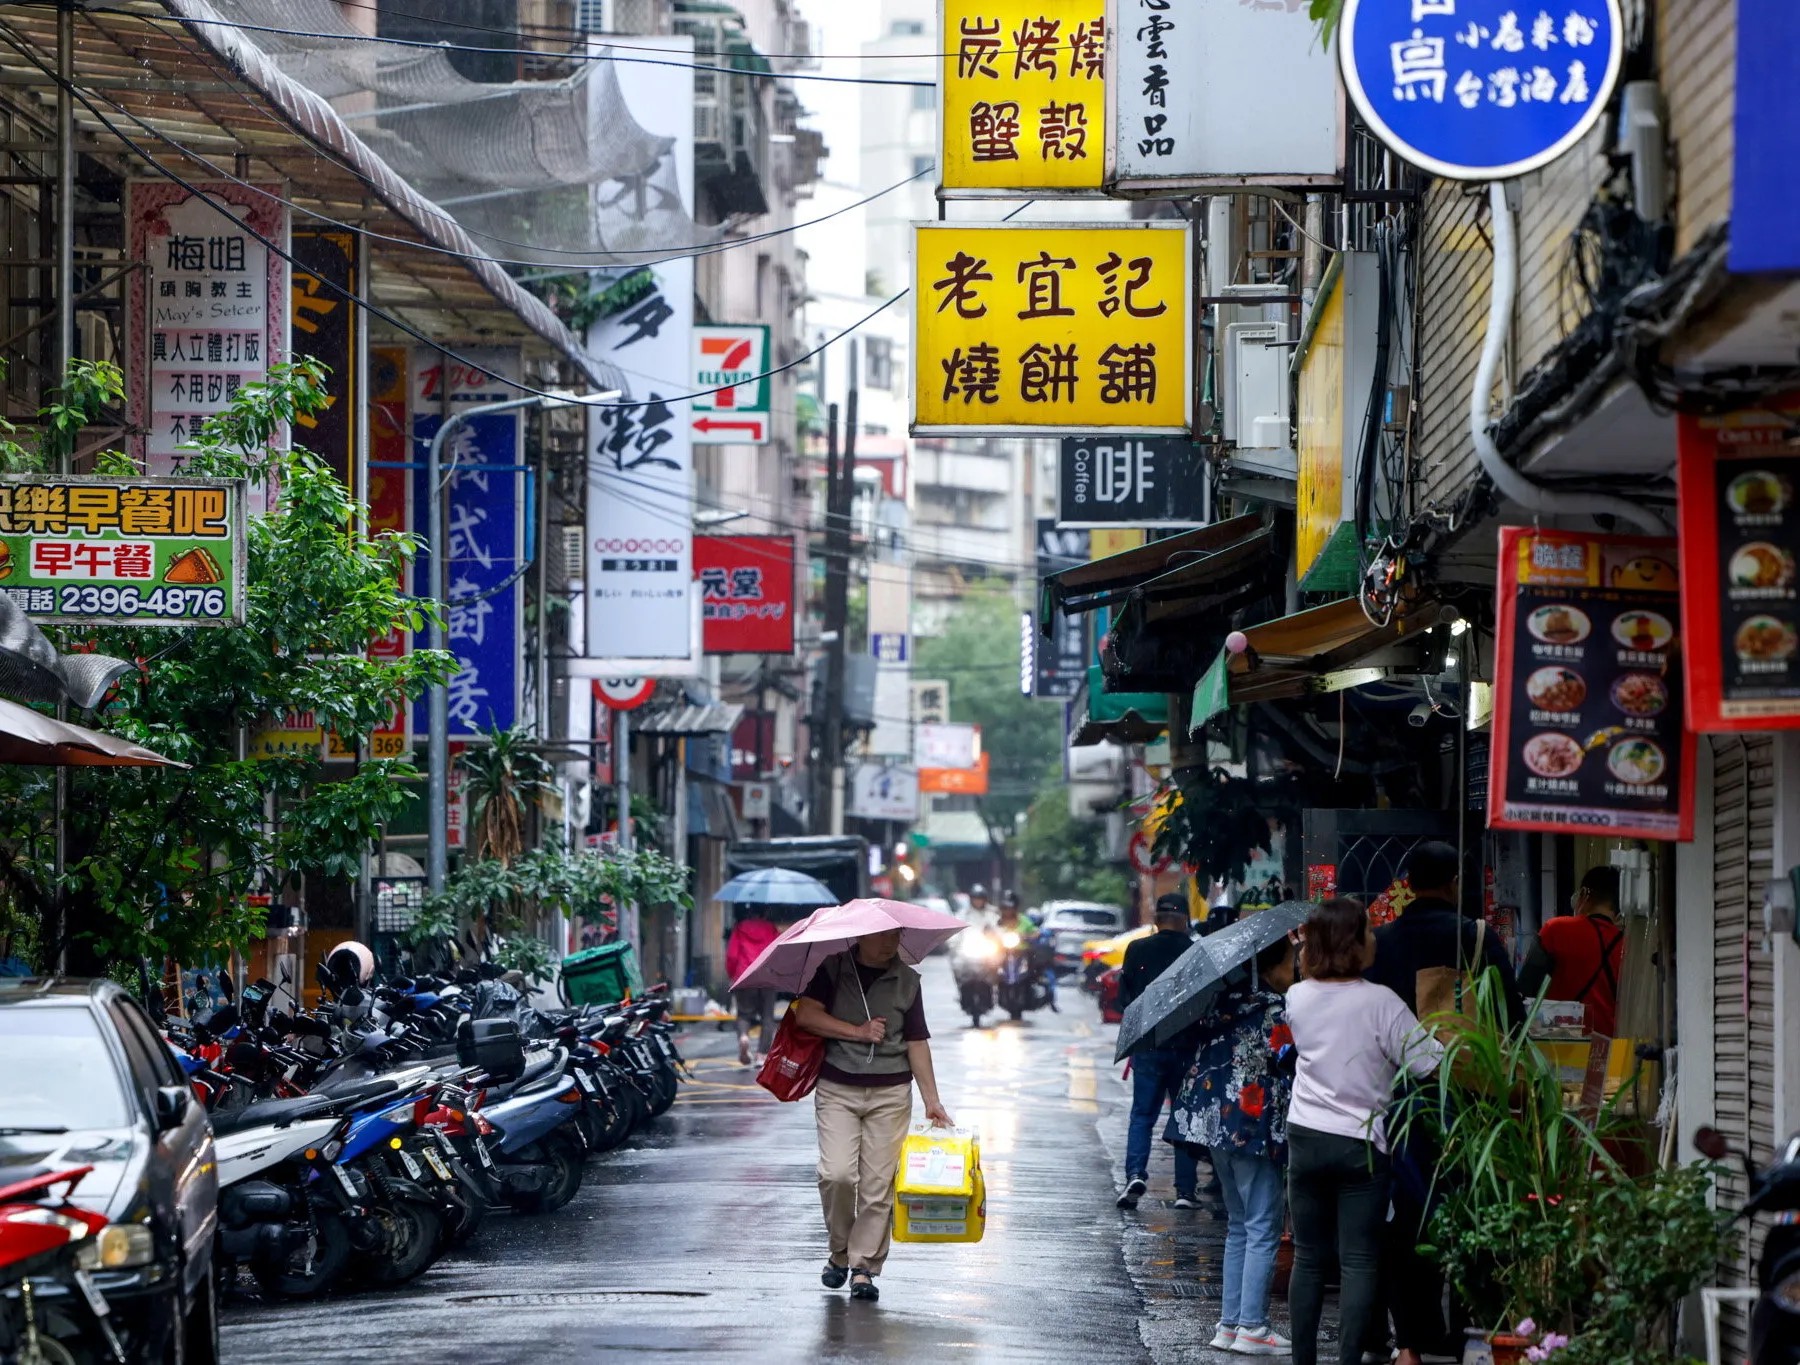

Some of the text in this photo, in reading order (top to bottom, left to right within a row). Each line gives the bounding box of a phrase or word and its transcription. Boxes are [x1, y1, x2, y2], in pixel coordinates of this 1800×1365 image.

[969, 100, 1087, 162] 蟹殼
[166, 235, 246, 272] 梅姐
[932, 250, 1167, 322] 老宜記
[1074, 448, 1090, 504] Coffee
[1095, 441, 1155, 504] 啡
[0, 486, 226, 535] 樂早餐吧
[34, 543, 151, 578] 早午餐
[61, 586, 223, 615] 2396-4876
